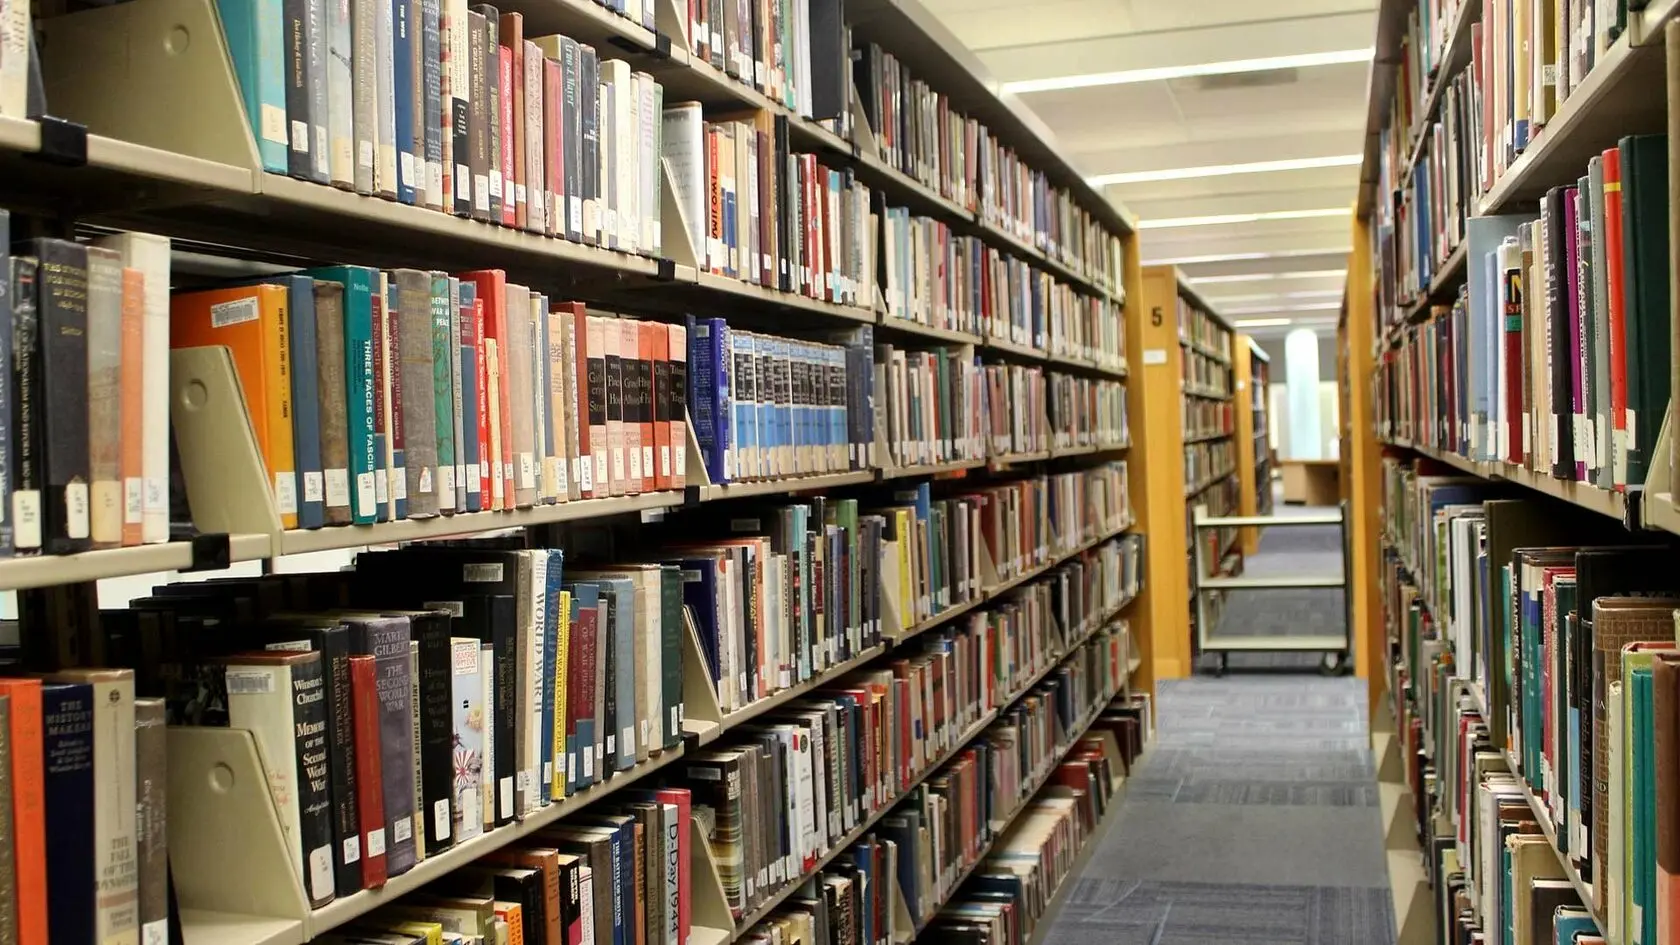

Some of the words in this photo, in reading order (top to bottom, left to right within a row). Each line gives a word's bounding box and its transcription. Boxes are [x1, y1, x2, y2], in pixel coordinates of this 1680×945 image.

[1151, 306, 1163, 327] 5
[21, 345, 29, 400] NATIONALISM
[21, 403, 29, 422] AND
[365, 379, 373, 414] FACES
[375, 388, 385, 426] Peace
[366, 417, 373, 431] OF
[366, 433, 374, 474] FASCIS
[534, 592, 545, 655] WORLD
[581, 627, 588, 640] OF
[333, 657, 341, 702] RICHARD
[534, 660, 545, 700] WAR
[46, 711, 92, 724] HISTORY
[60, 700, 83, 711] THE
[1581, 697, 1591, 743] Inside
[48, 723, 91, 736] MAKERS
[1581, 746, 1591, 812] Australia
[110, 848, 130, 862] FALL
[112, 836, 129, 850] THE
[667, 823, 679, 886] D-Day
[104, 865, 116, 876] OF
[670, 890, 679, 933] 1944
